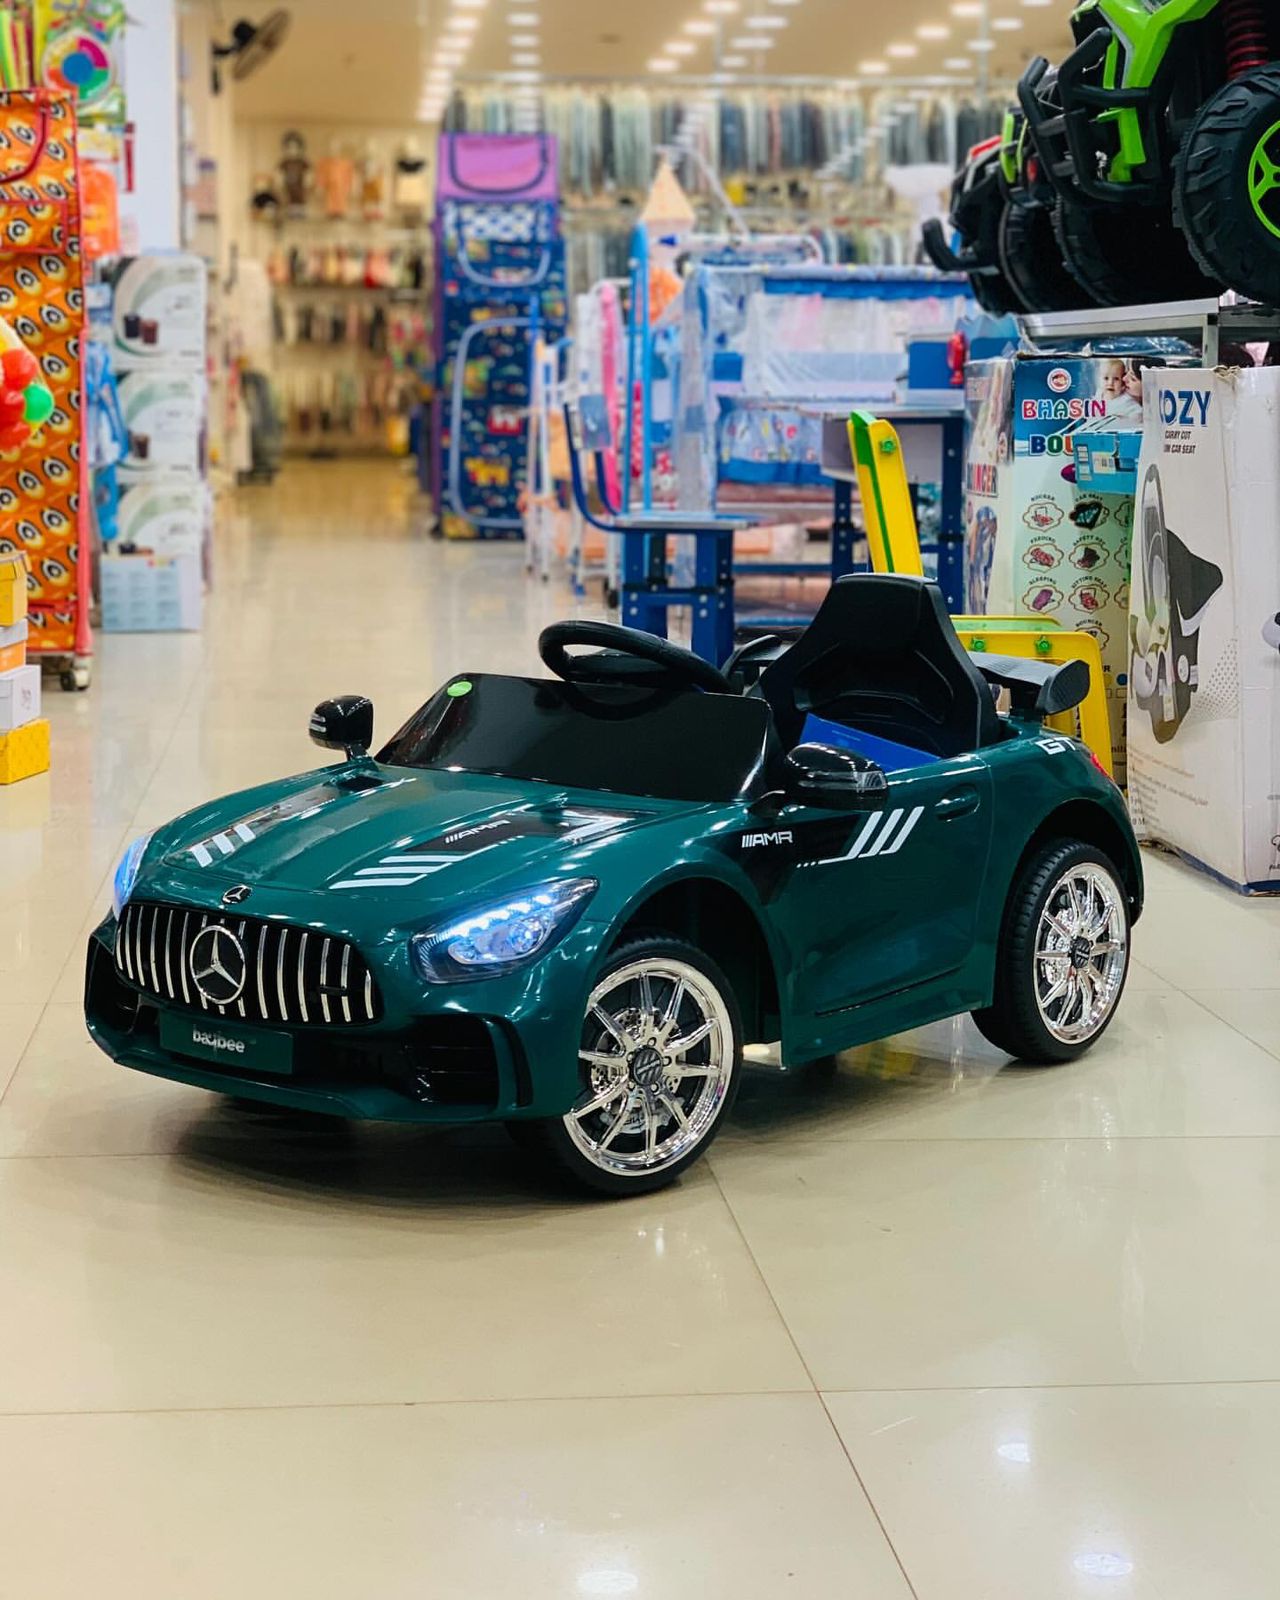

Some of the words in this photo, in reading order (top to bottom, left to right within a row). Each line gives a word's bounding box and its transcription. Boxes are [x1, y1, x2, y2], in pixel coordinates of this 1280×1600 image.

[1022, 399, 1106, 420] BHASIN
[1165, 430, 1181, 440] CARRY
[1182, 444, 1196, 454] SEAT
[1035, 736, 1076, 755] GT
